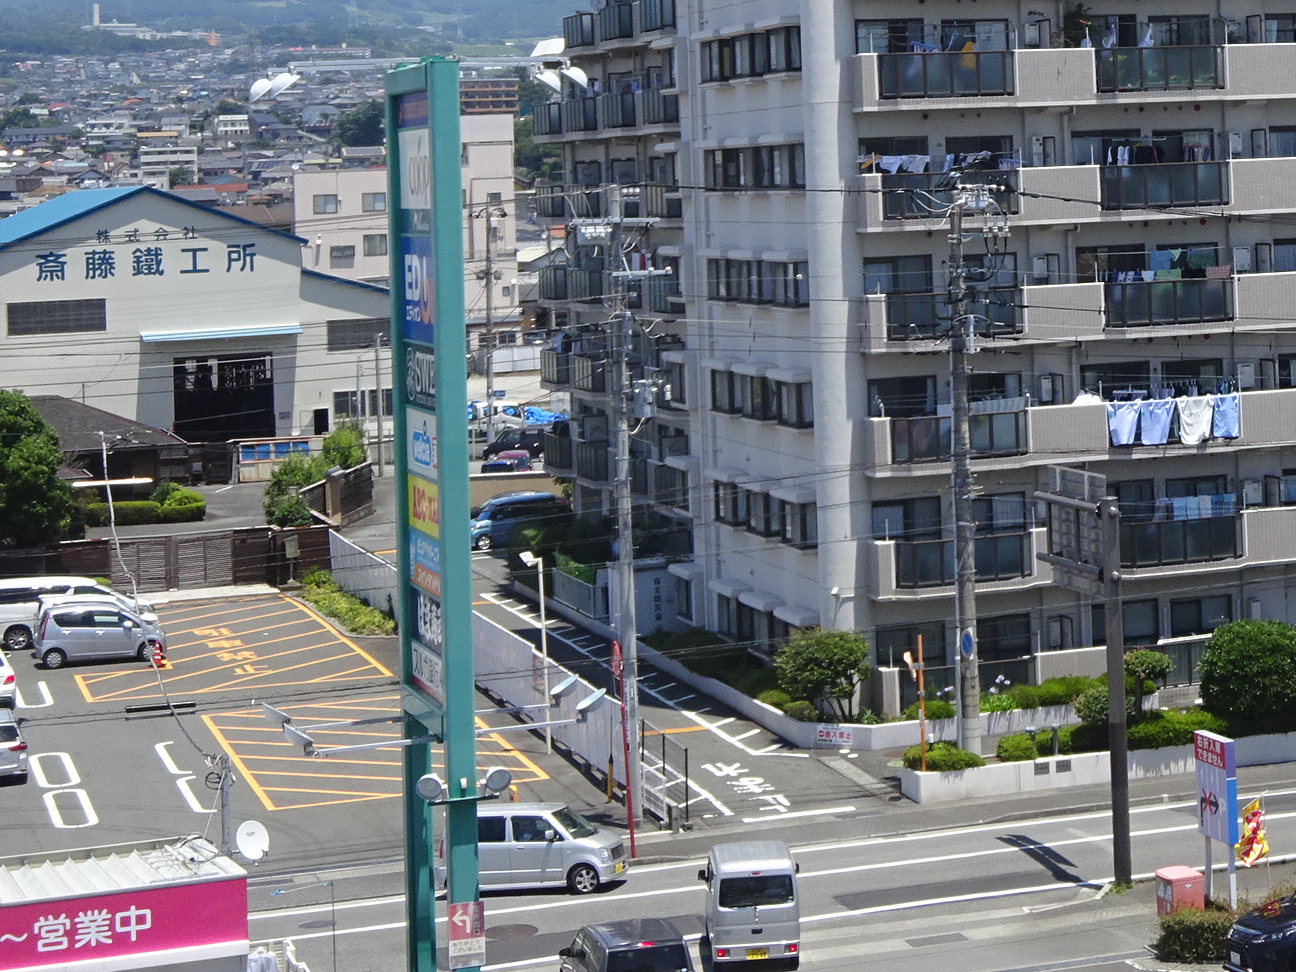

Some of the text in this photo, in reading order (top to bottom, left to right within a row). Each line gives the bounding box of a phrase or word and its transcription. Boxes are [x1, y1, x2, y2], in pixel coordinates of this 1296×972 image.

[95, 226, 198, 244] 株式会社
[825, 730, 852, 740] 進入禁止
[1197, 748, 1224, 768] できません
[701, 762, 791, 813] 止まれ
